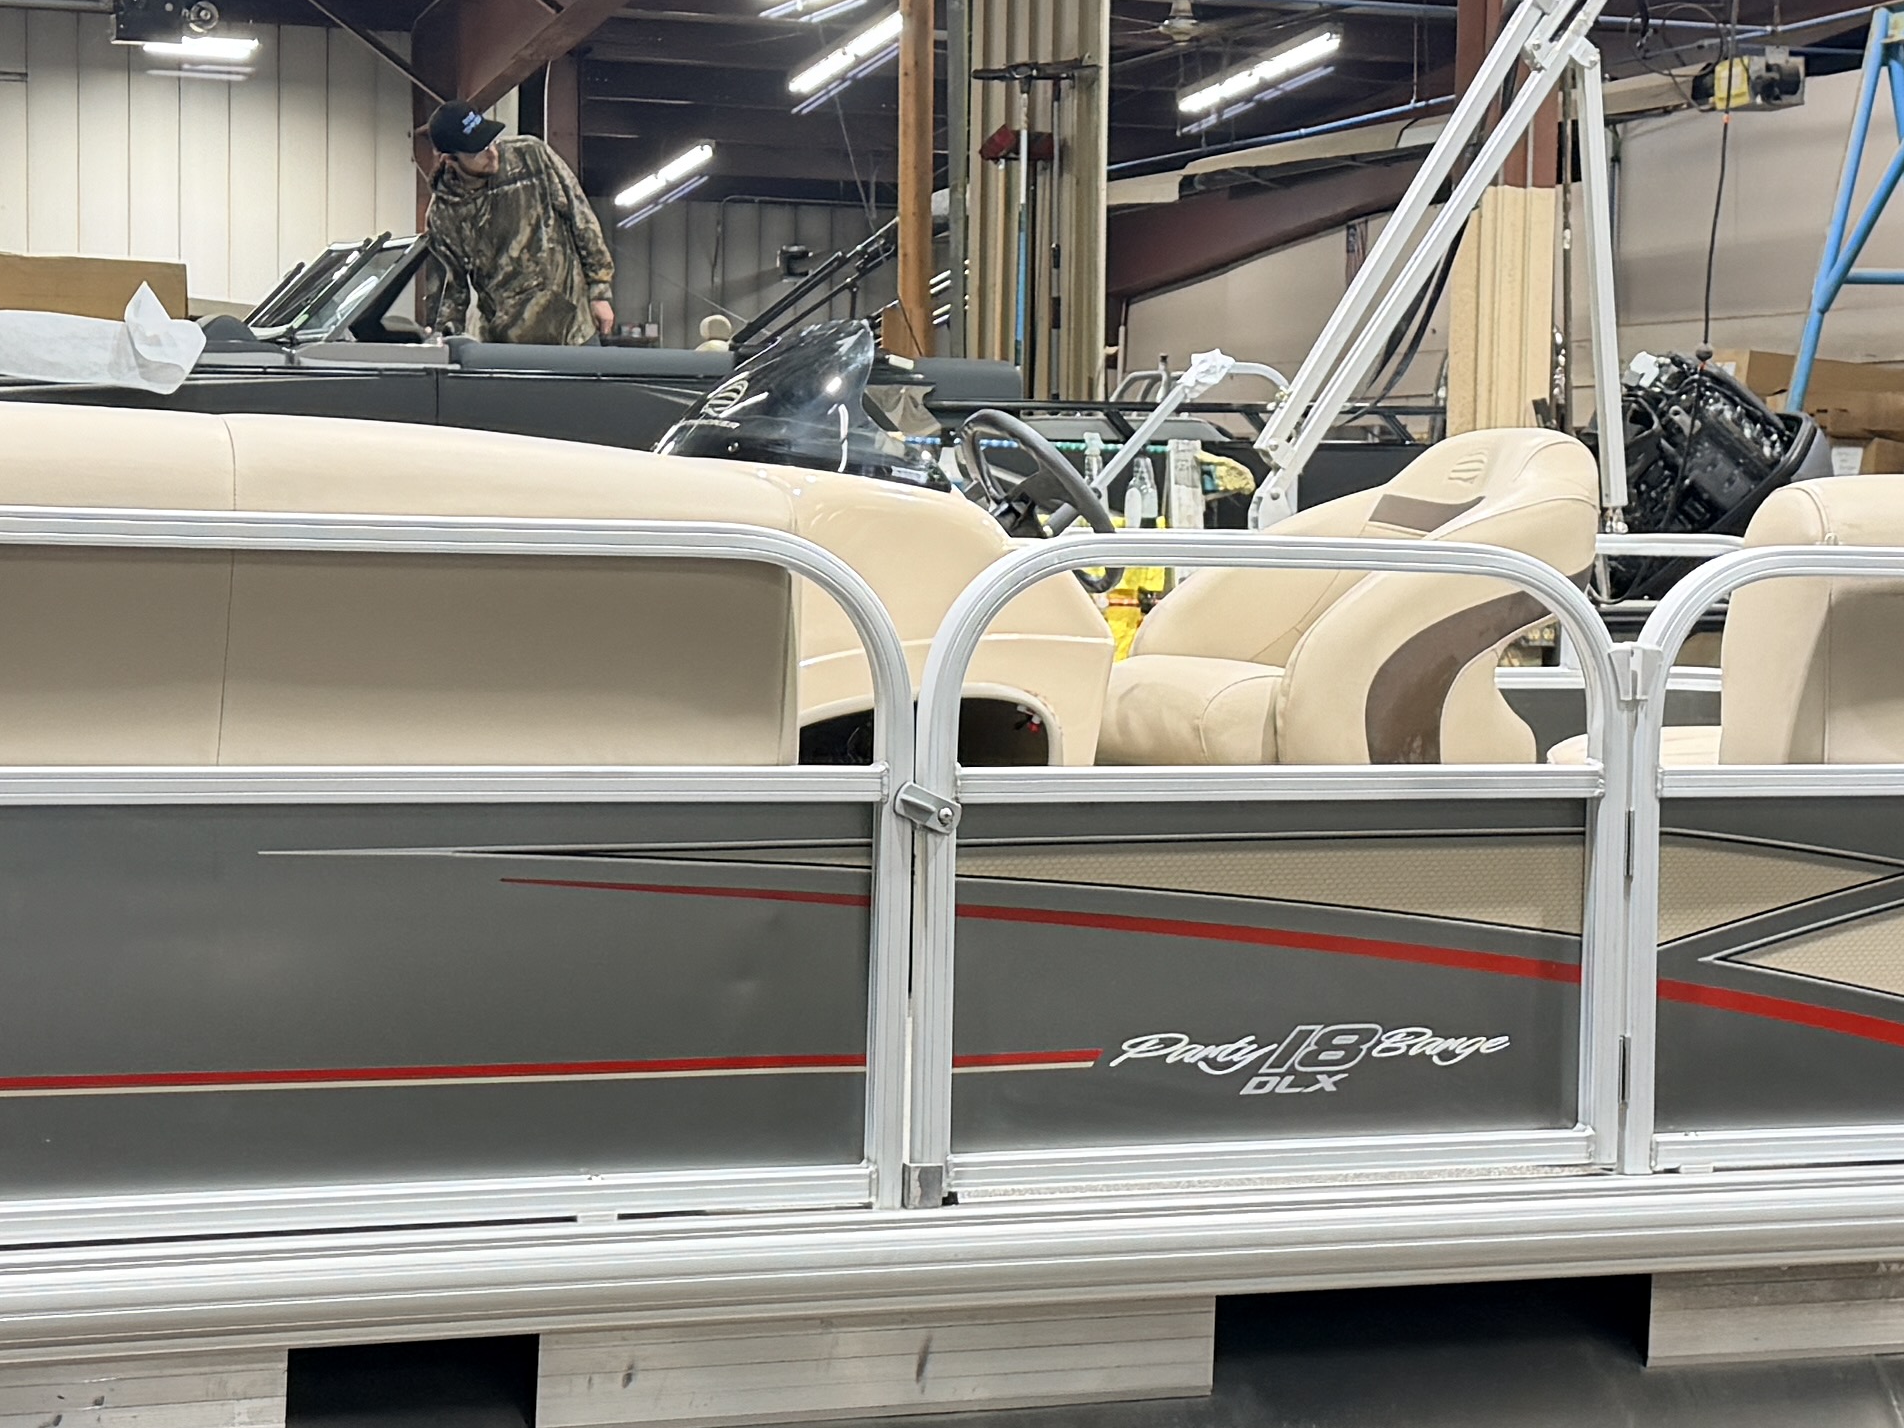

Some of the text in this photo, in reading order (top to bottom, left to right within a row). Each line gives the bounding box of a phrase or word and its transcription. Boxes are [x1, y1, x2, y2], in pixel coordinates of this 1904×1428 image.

[1109, 1023, 1510, 1075] Party 18 Barge
[1238, 1073, 1348, 1096] DLX
